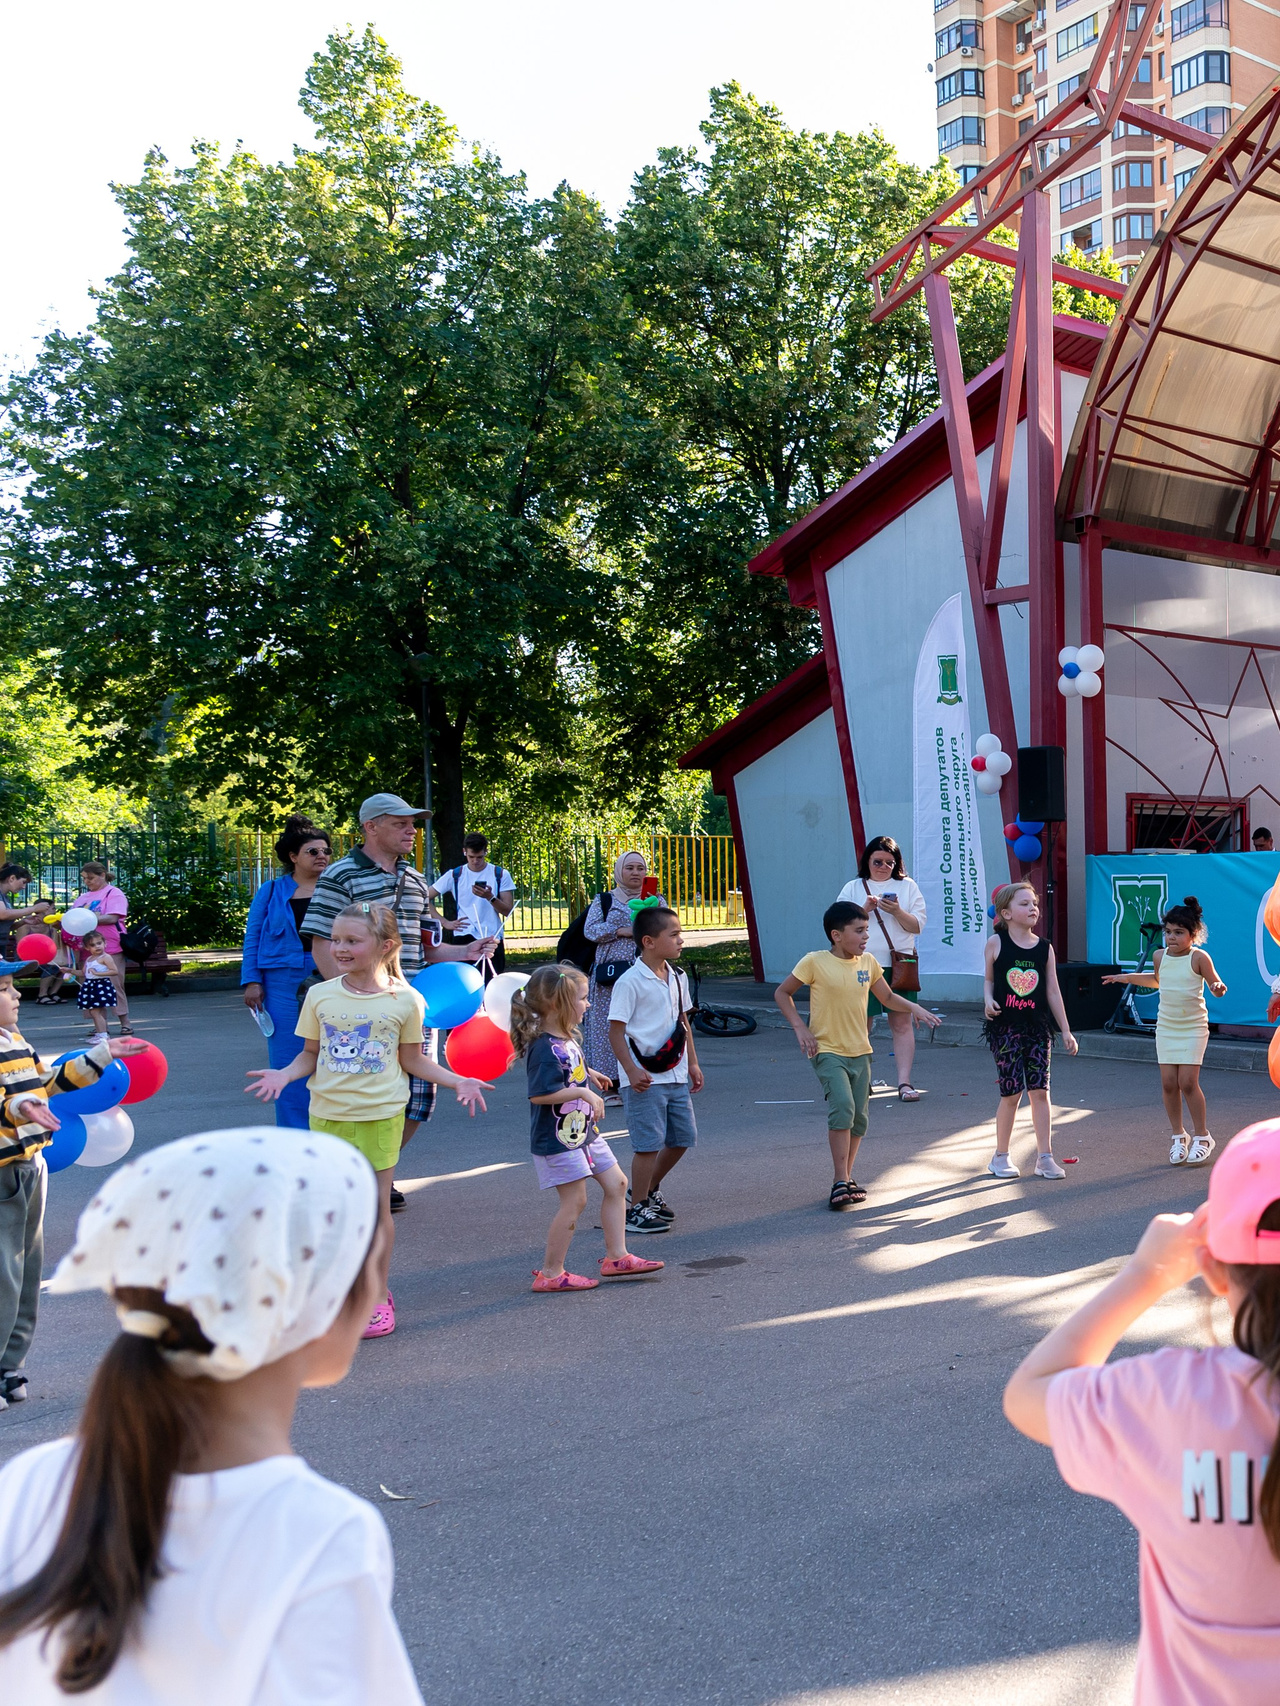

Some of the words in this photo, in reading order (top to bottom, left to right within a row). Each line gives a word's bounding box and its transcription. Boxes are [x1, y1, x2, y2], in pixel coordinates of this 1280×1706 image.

[936, 727, 952, 812] депутатов
[951, 736, 961, 790] округа
[940, 816, 952, 874] Совета
[955, 795, 973, 933] муниципального
[941, 878, 956, 947] Аппарат
